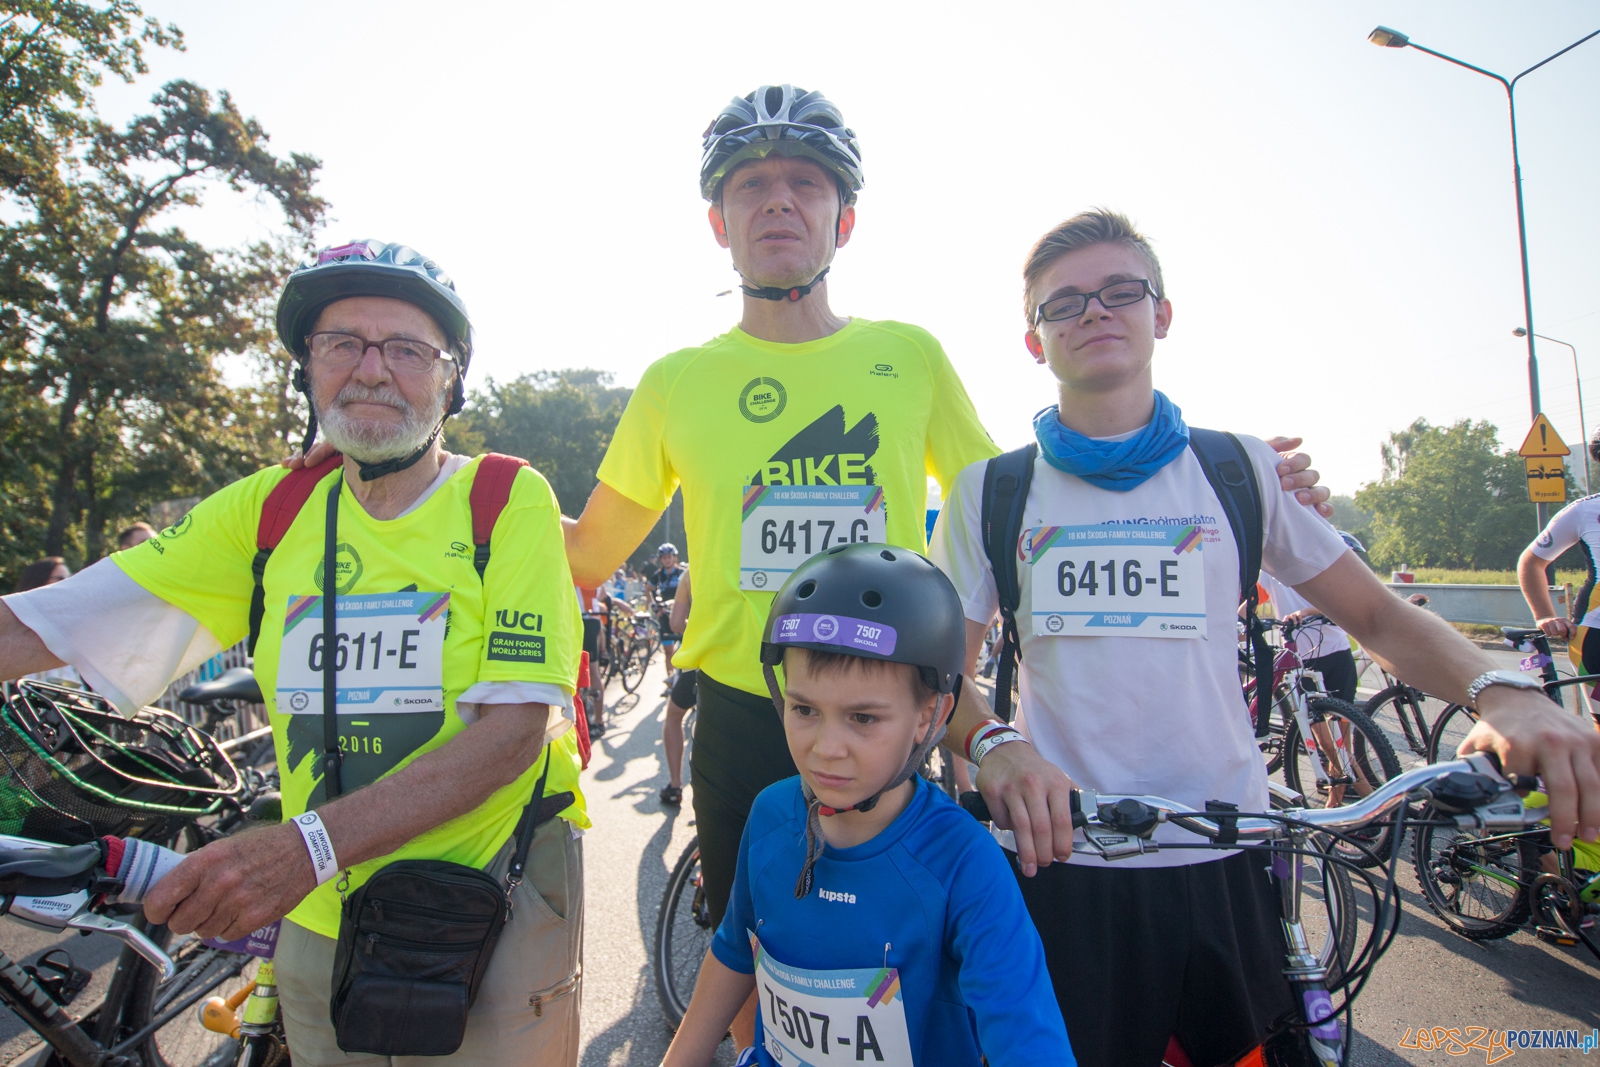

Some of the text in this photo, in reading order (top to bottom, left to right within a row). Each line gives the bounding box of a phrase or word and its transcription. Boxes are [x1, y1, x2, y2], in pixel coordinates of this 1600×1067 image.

[869, 370, 899, 379] Kalenji
[750, 398, 776, 406] CHALLENGE
[753, 392, 772, 402] BIKE
[761, 453, 868, 486] BIKE
[773, 490, 860, 500] 18 KM ŠKODA FAMILY CHALLENGE
[761, 518, 869, 554] 6417-G
[1067, 529, 1167, 541] 18 KM ŠKODA FAMILY CHALLENGE
[1057, 559, 1180, 597] 6416-E
[344, 600, 363, 610] ŠKODA
[363, 600, 381, 610] FAMILY
[381, 599, 413, 609] CHALLENGE
[500, 609, 543, 632] UCI
[781, 618, 800, 631] 7507
[1103, 614, 1132, 625] POZNAŃ
[855, 624, 882, 640] 7507
[492, 638, 542, 649] GRAN FONDO
[853, 637, 878, 648] ŠKODA
[308, 630, 420, 672] 6611-E
[491, 647, 542, 657] WORLD SERIES
[347, 688, 371, 701] POZNAŃ
[403, 697, 433, 705] ŠKODA
[338, 735, 383, 755] 2016
[307, 831, 326, 872] COMPETITOR
[315, 828, 332, 862] ZAWODNIK
[818, 887, 857, 904] kipsta
[32, 898, 72, 910] SHIMANO
[790, 974, 813, 988] FAMILY
[813, 978, 856, 989] CHALLENGE
[764, 982, 885, 1062] 7507-A
